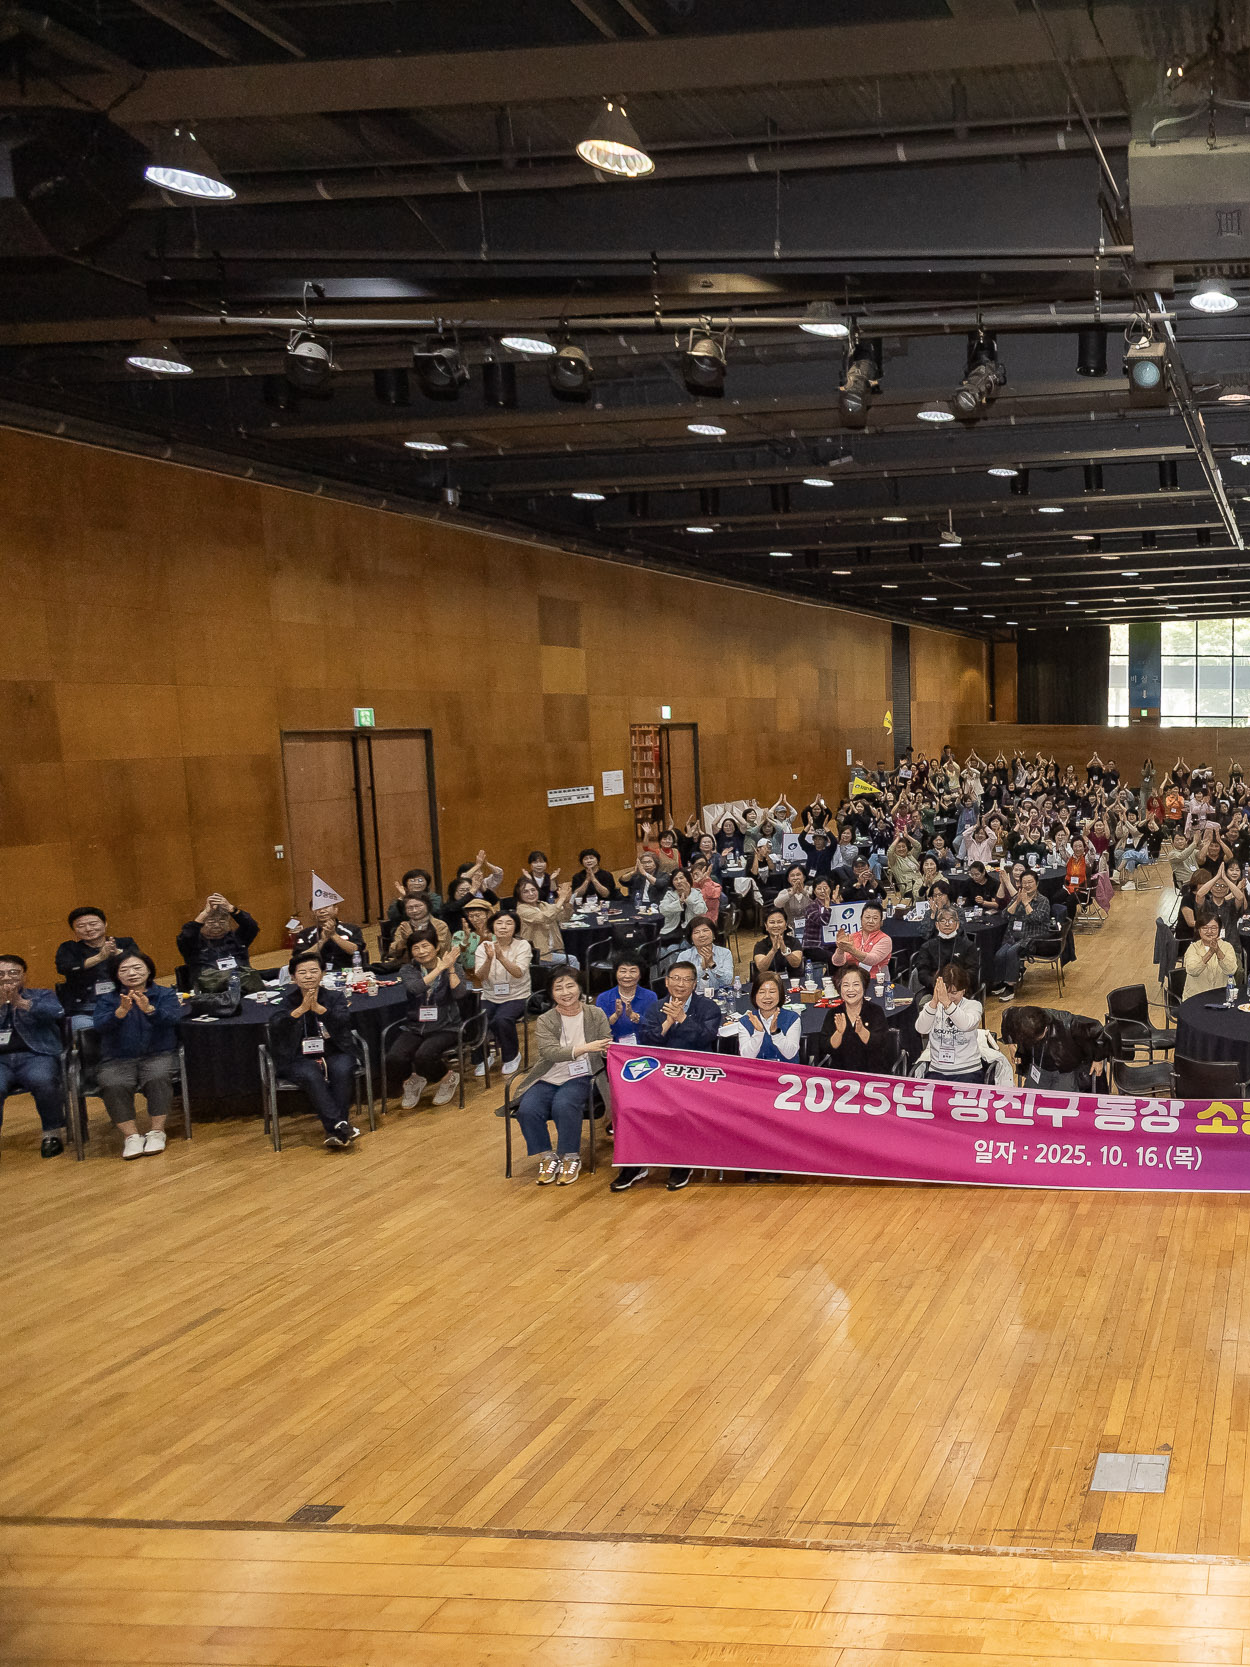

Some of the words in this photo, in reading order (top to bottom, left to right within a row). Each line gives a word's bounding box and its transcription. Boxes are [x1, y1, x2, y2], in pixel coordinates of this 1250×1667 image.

[1131, 674, 1160, 684] 비상구
[828, 923, 865, 937] 구의1
[661, 1064, 727, 1083] 광진구
[773, 1074, 935, 1119] 2025년
[947, 1086, 1080, 1128] 광진구
[1094, 1097, 1185, 1133] 통장
[974, 1139, 1017, 1165] 일자
[1034, 1143, 1092, 1167] 2025.
[1099, 1145, 1128, 1168] 10.
[1135, 1145, 1203, 1171] 16.(목)
